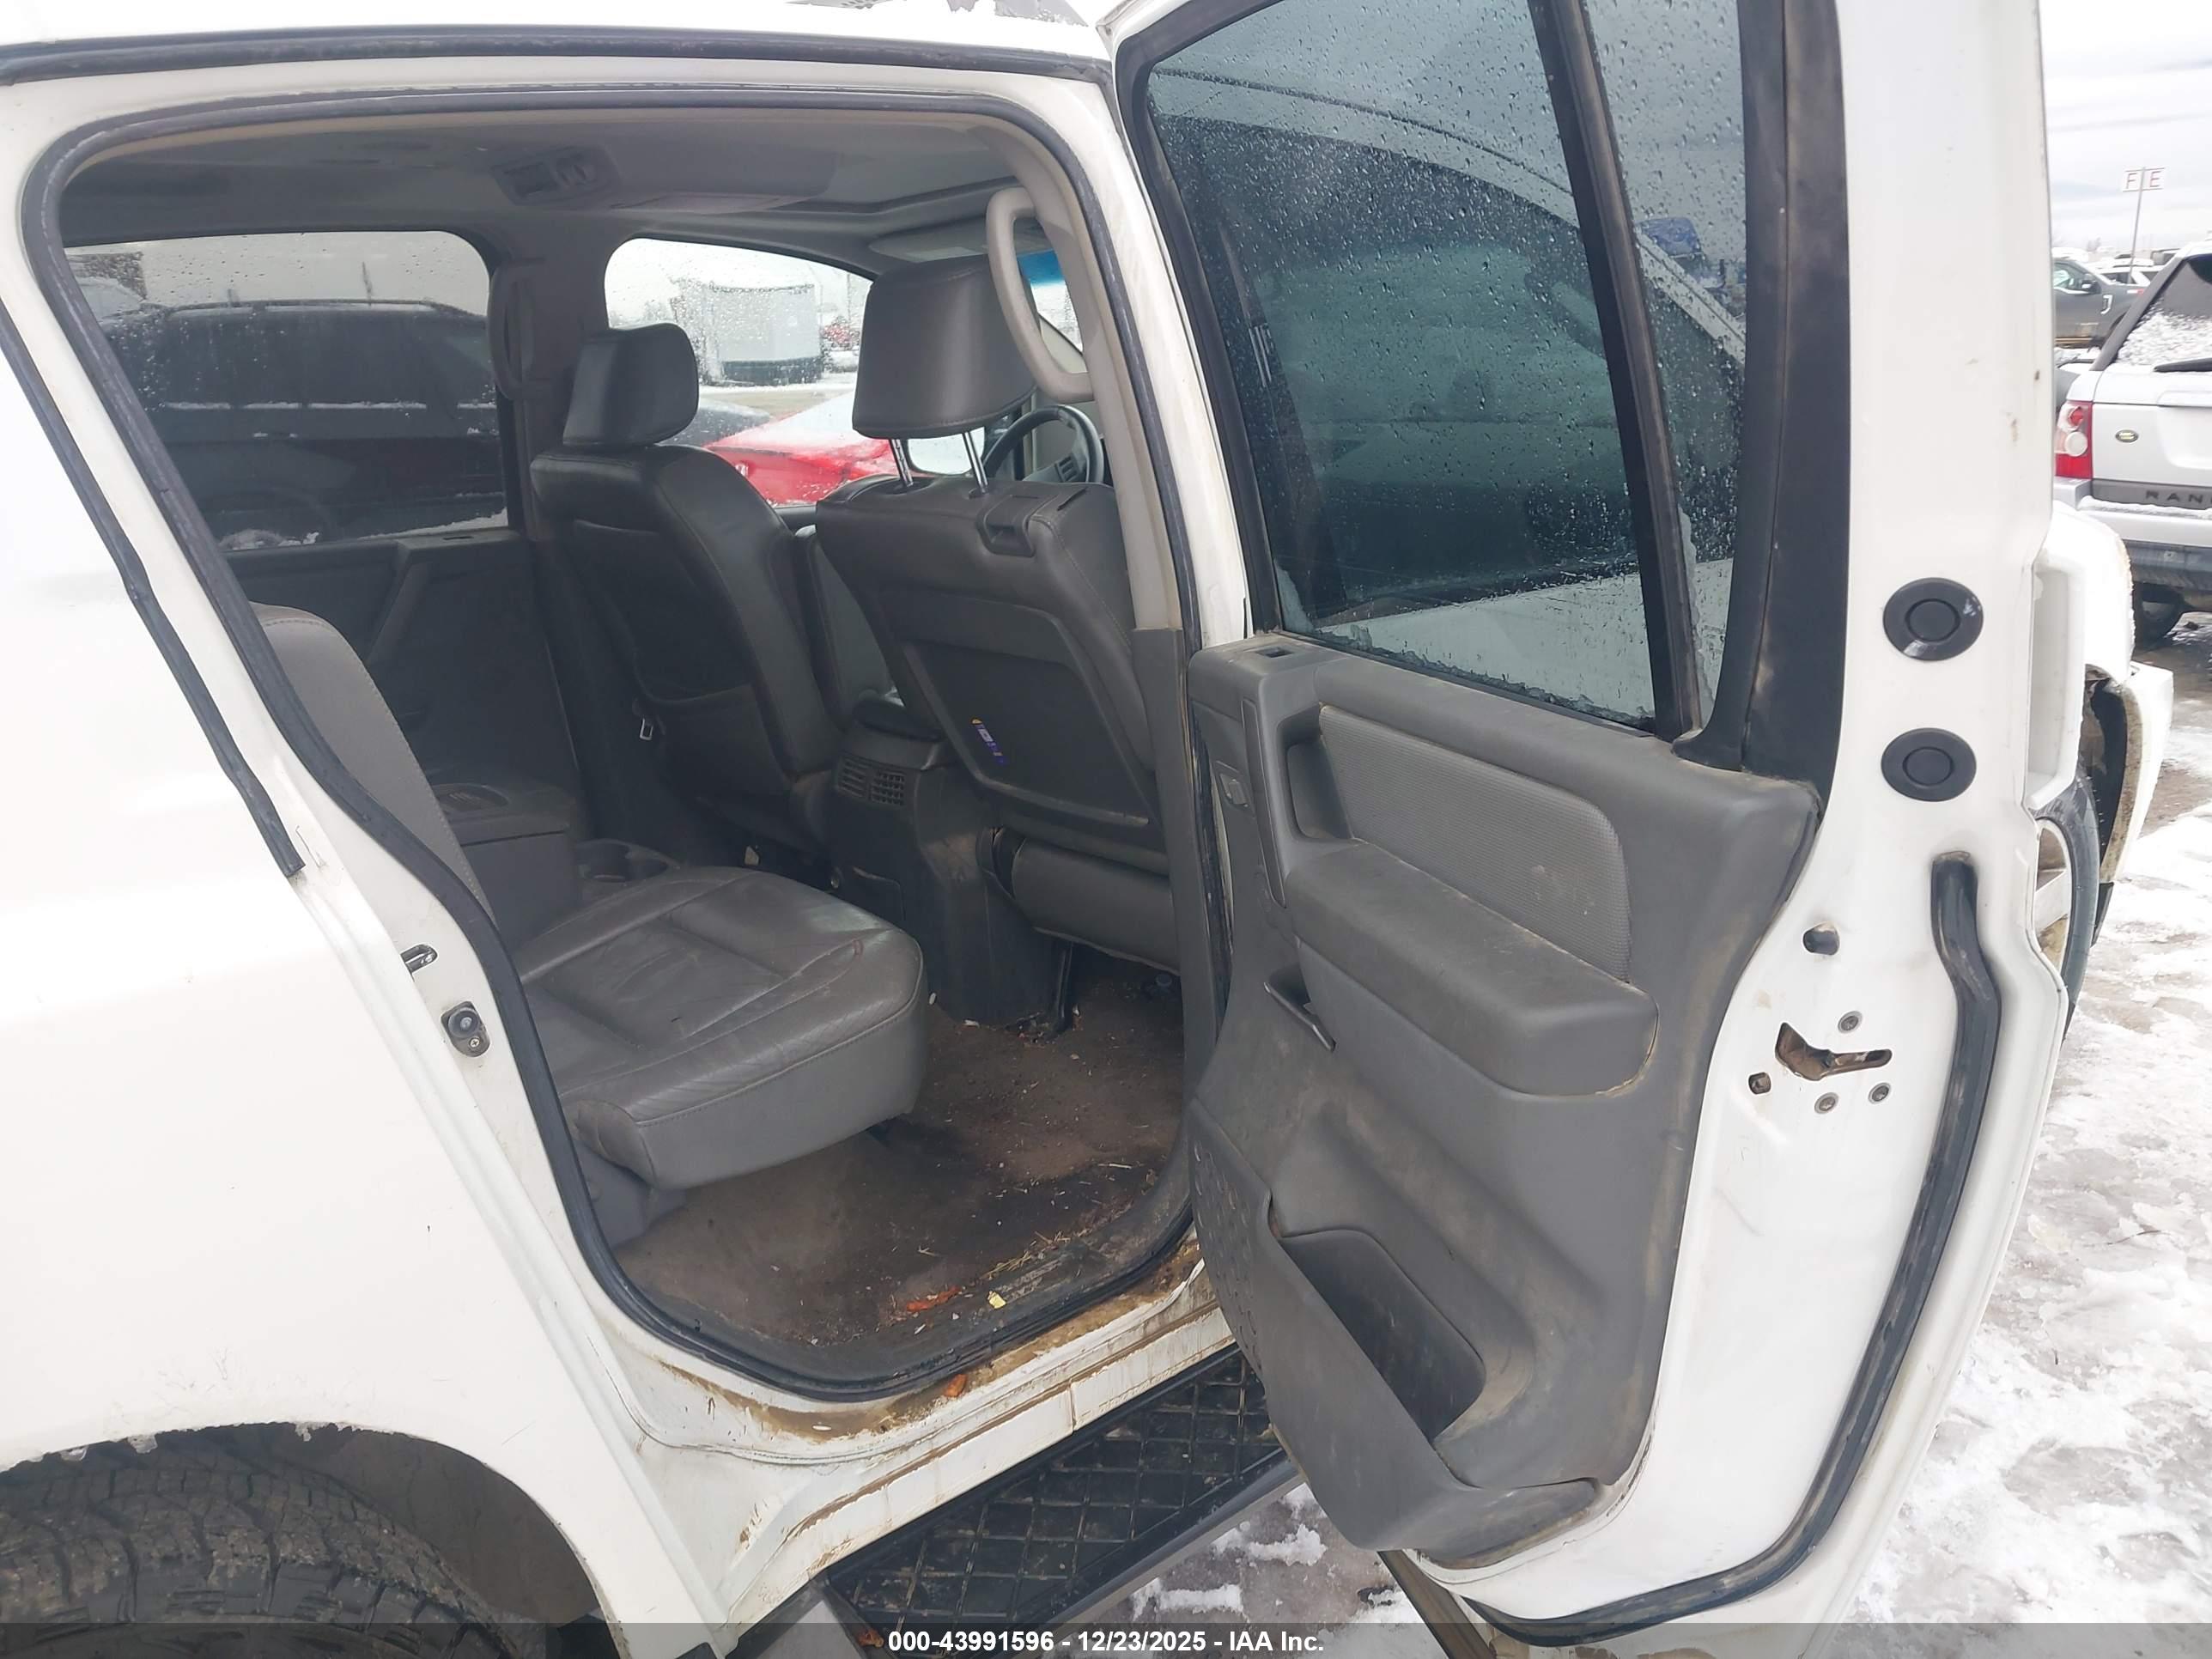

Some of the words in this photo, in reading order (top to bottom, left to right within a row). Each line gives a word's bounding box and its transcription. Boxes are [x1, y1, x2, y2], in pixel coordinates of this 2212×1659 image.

[2125, 172, 2138, 189] F
[2149, 170, 2162, 187] E
[2145, 489, 2212, 504] RAN
